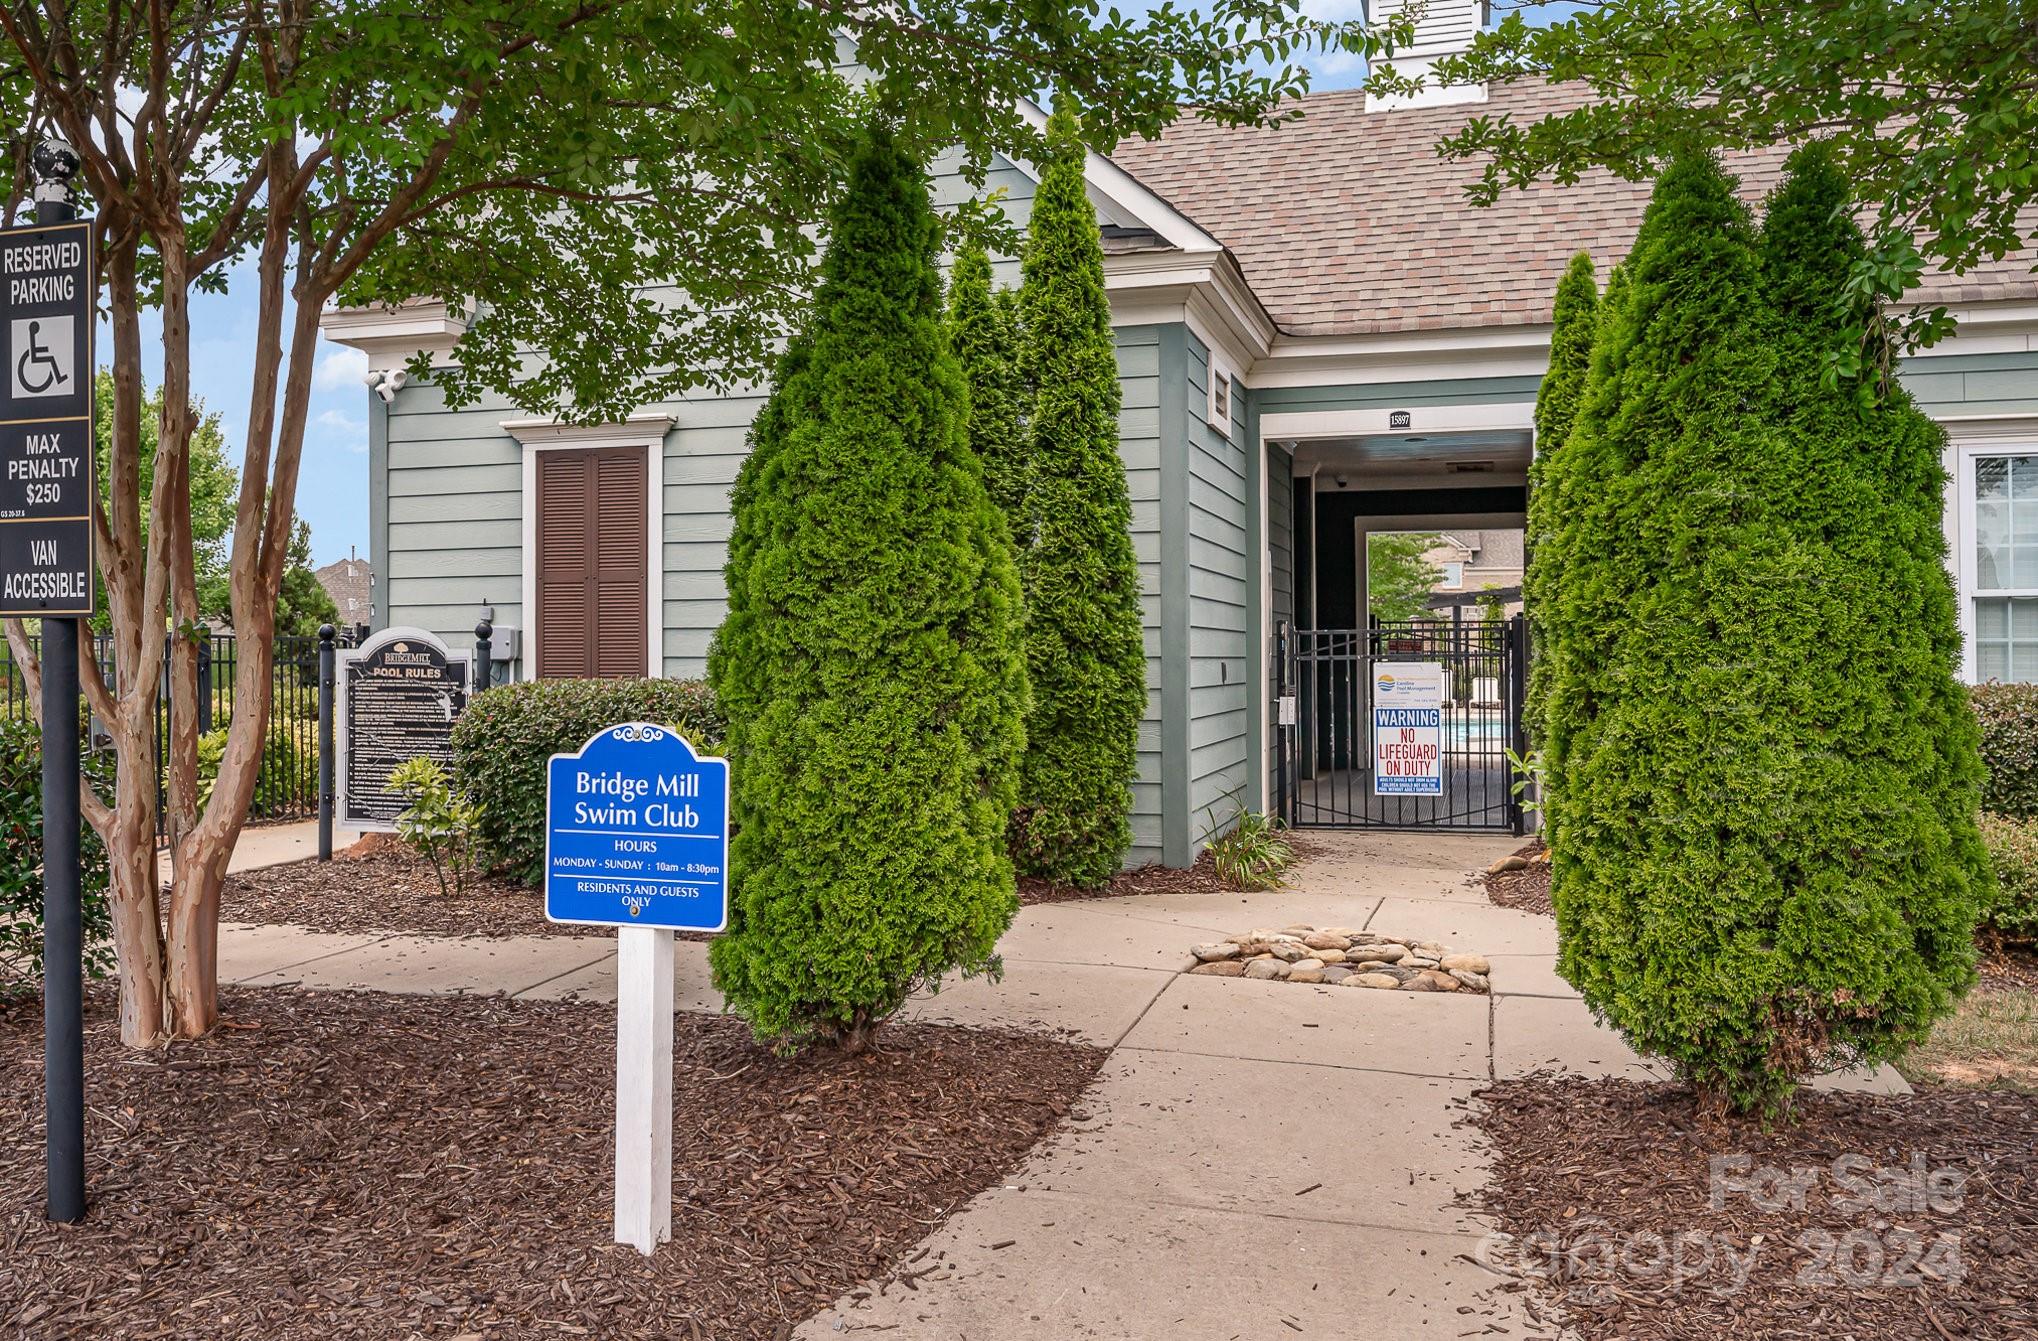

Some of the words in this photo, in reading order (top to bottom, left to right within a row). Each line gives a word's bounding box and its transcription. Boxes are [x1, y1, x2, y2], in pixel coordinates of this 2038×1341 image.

[4, 241, 81, 274] RESERVED
[11, 274, 75, 306] PARKING
[1391, 415, 1409, 425] 15897
[26, 433, 61, 455] MAX
[8, 457, 79, 480] PENALTY
[26, 483, 61, 506] $250
[31, 540, 57, 566] VAN
[4, 571, 86, 599] ACCESSIBLE
[373, 668, 403, 678] POOL
[405, 668, 441, 678] RULES
[1378, 710, 1438, 726] WARNING
[1401, 728, 1415, 743] NO
[1379, 744, 1437, 760] LIFEGUARD
[1386, 760, 1400, 775] ON
[1404, 760, 1431, 776] DUTY
[576, 771, 649, 803] Bridge
[655, 773, 699, 798] Mill
[575, 801, 637, 826] Swim
[644, 803, 700, 829] Club
[614, 839, 657, 853] HOURS
[553, 857, 597, 868] MONDAY
[604, 859, 644, 870] SUNDAY
[655, 862, 679, 872] 10am
[686, 863, 720, 876] 8:30pm
[577, 882, 631, 895] RESIDENTS
[634, 885, 657, 896] AND
[660, 886, 699, 898] GUESTS
[621, 895, 651, 907] ONLY
